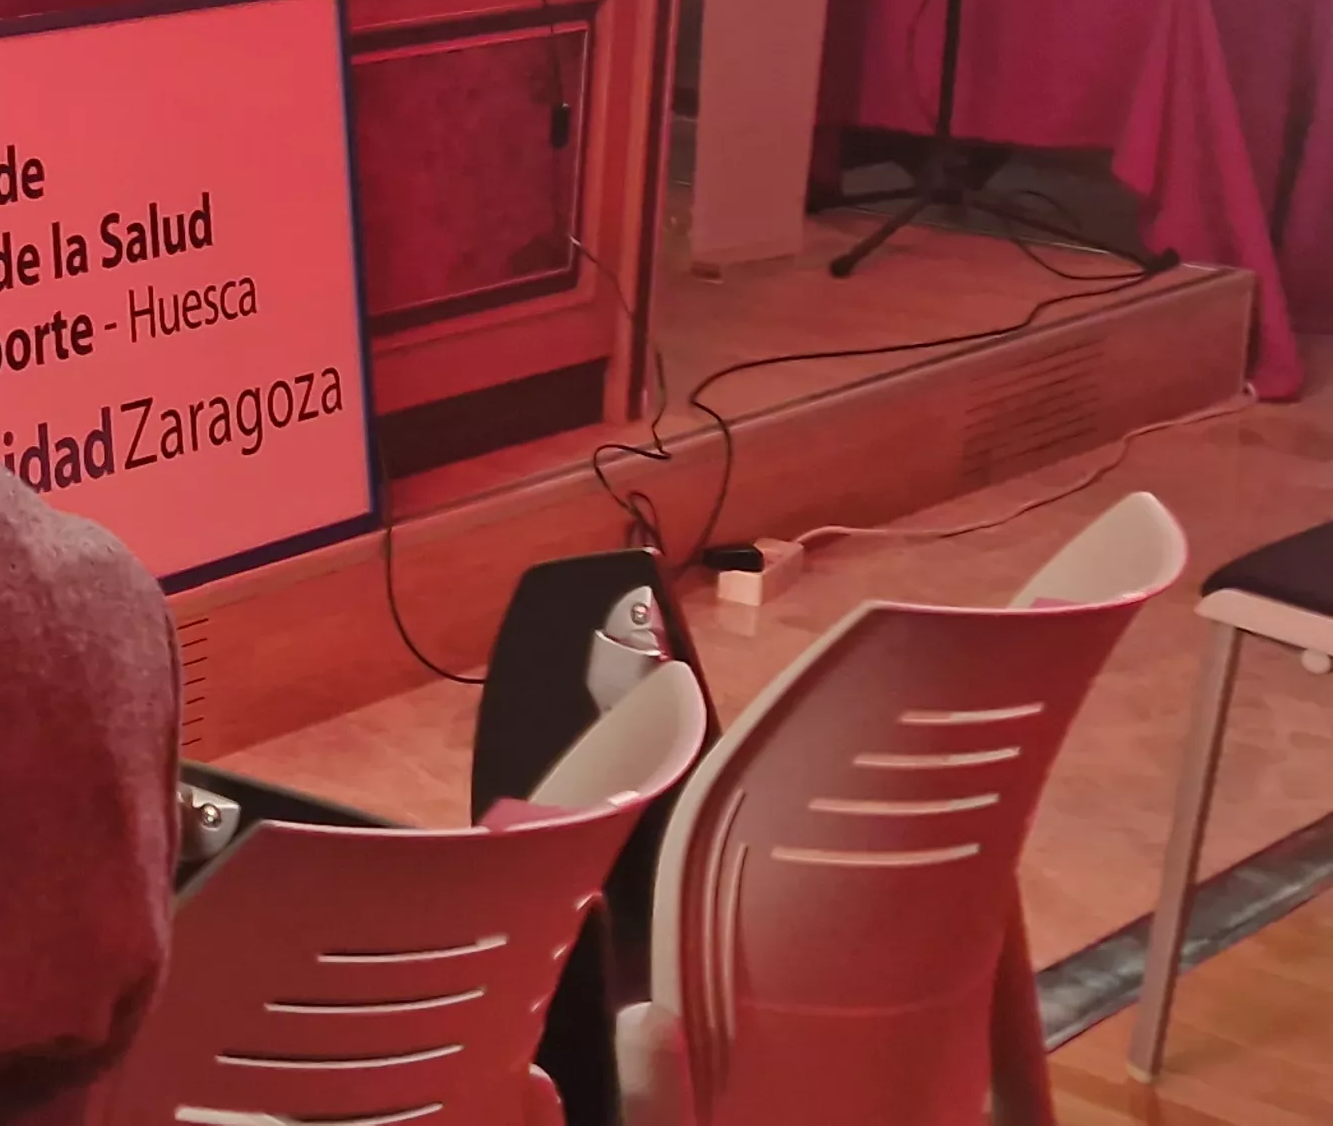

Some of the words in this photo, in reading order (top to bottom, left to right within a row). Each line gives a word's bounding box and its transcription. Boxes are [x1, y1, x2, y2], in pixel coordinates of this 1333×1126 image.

[51, 221, 90, 280] la
[99, 191, 214, 269] Salud
[128, 276, 258, 343] Huesca
[120, 366, 344, 471] Zaragoza
